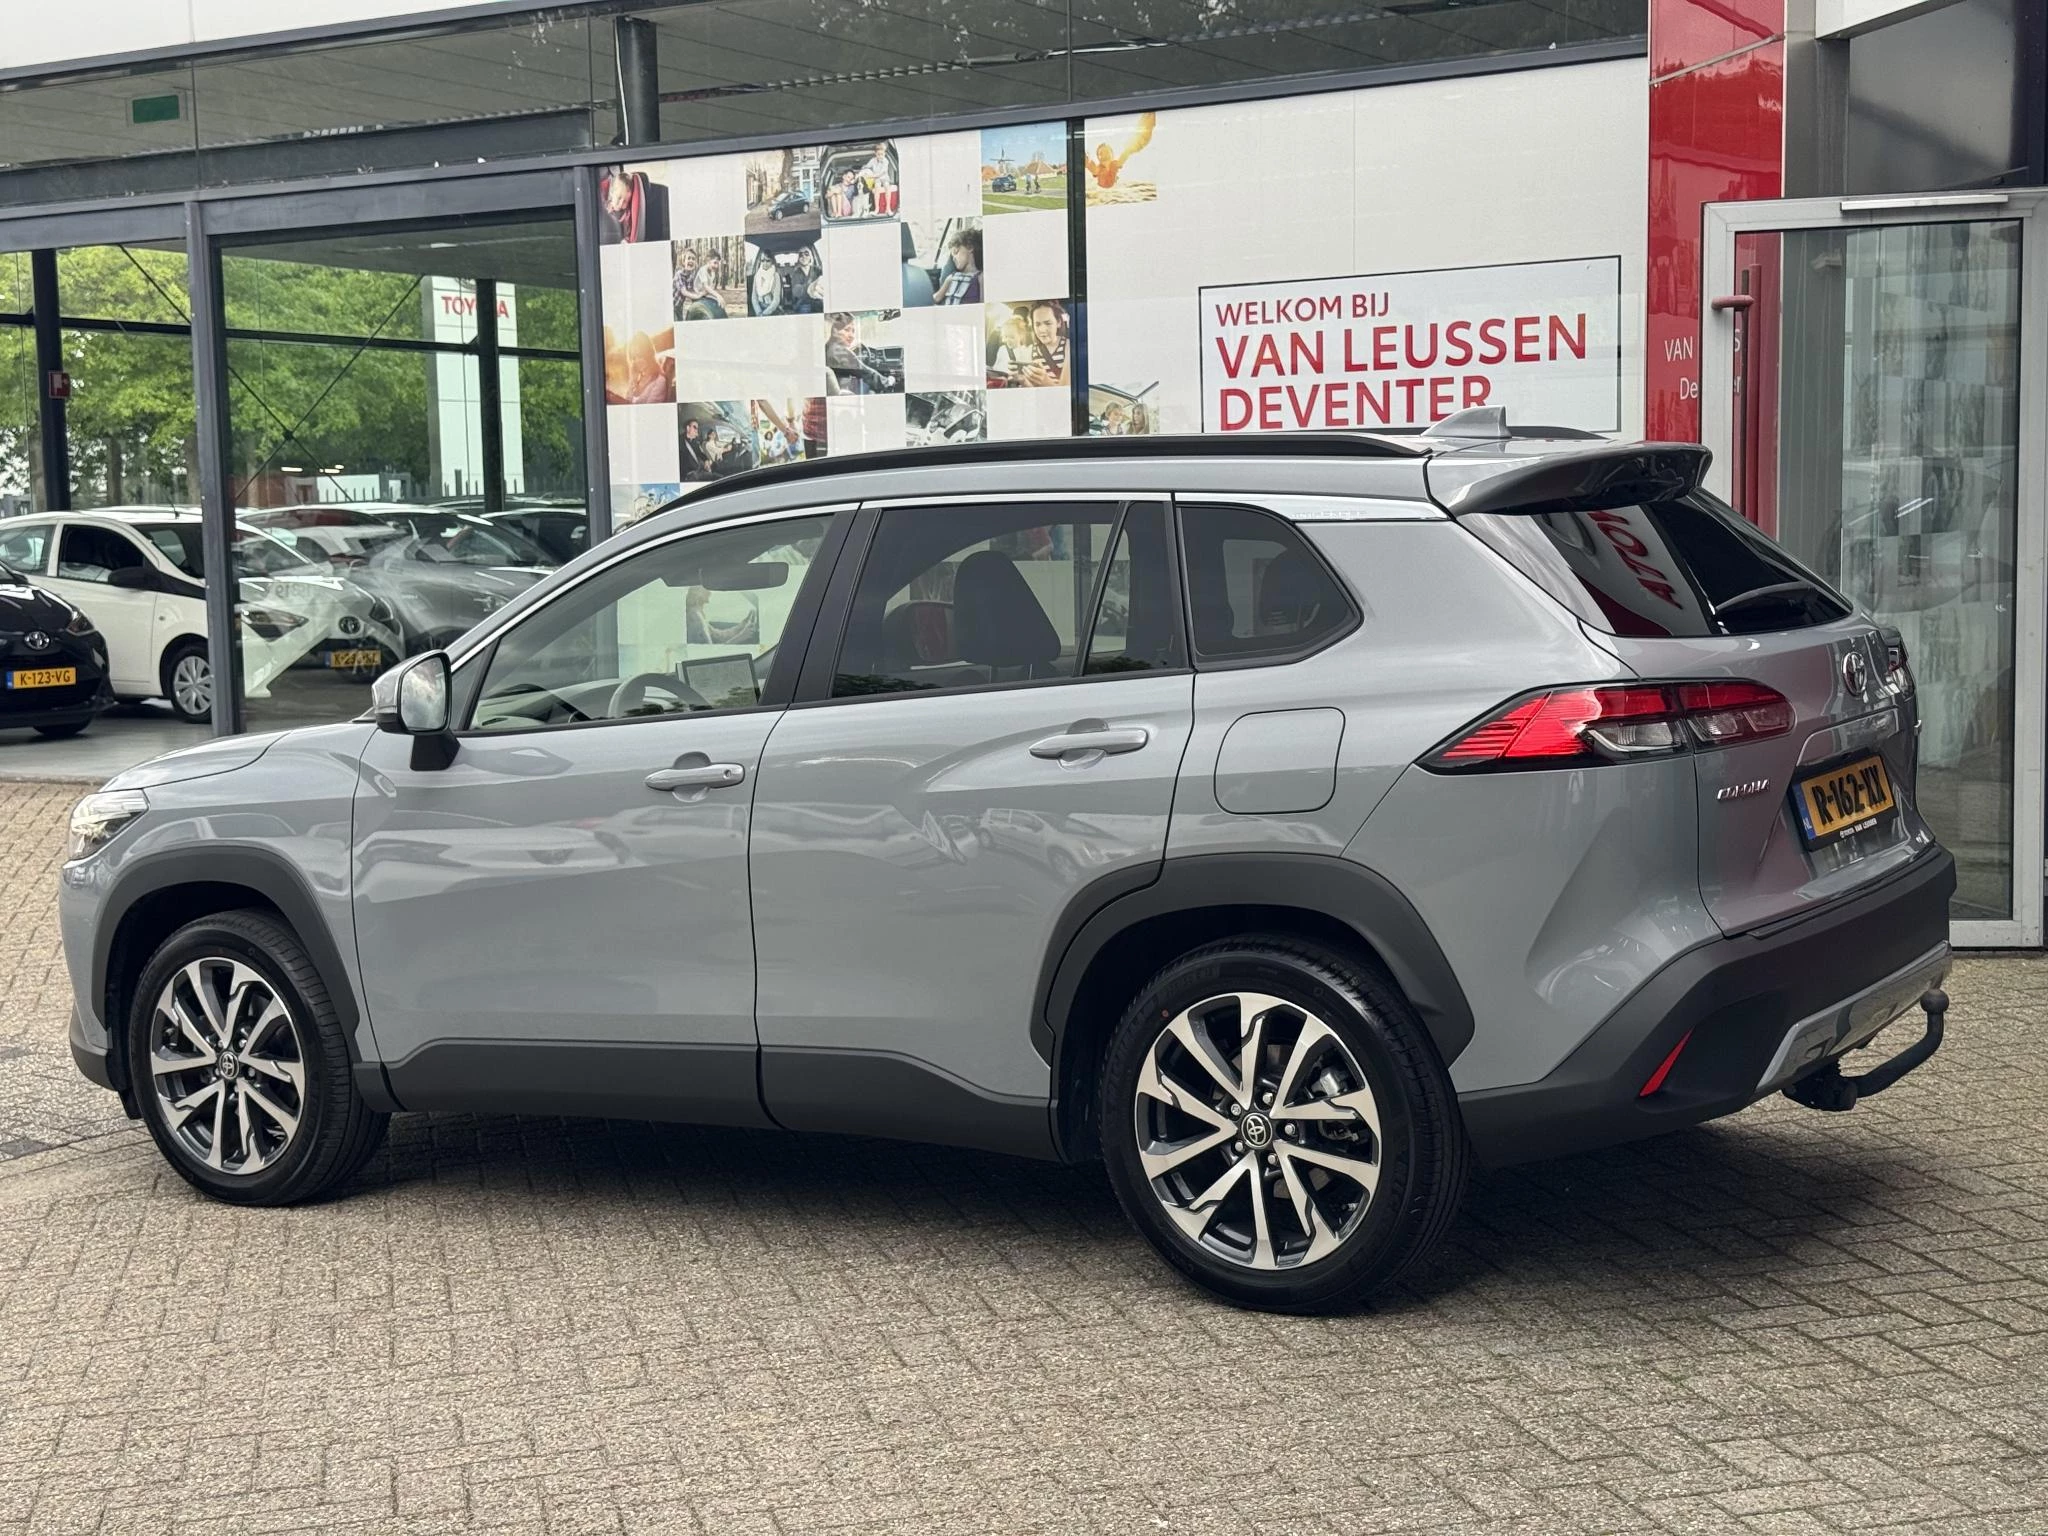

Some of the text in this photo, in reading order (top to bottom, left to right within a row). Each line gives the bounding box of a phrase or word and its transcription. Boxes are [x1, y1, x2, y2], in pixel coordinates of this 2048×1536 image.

[441, 295, 510, 319] TOYA
[1215, 292, 1389, 327] WELKOM BIJ
[1215, 313, 1587, 379] VAN LEUSSEN
[1664, 336, 1693, 362] VAN
[1680, 377, 1698, 400] De
[1219, 375, 1491, 432] DEVENTER
[20, 670, 71, 686] K-123-VG
